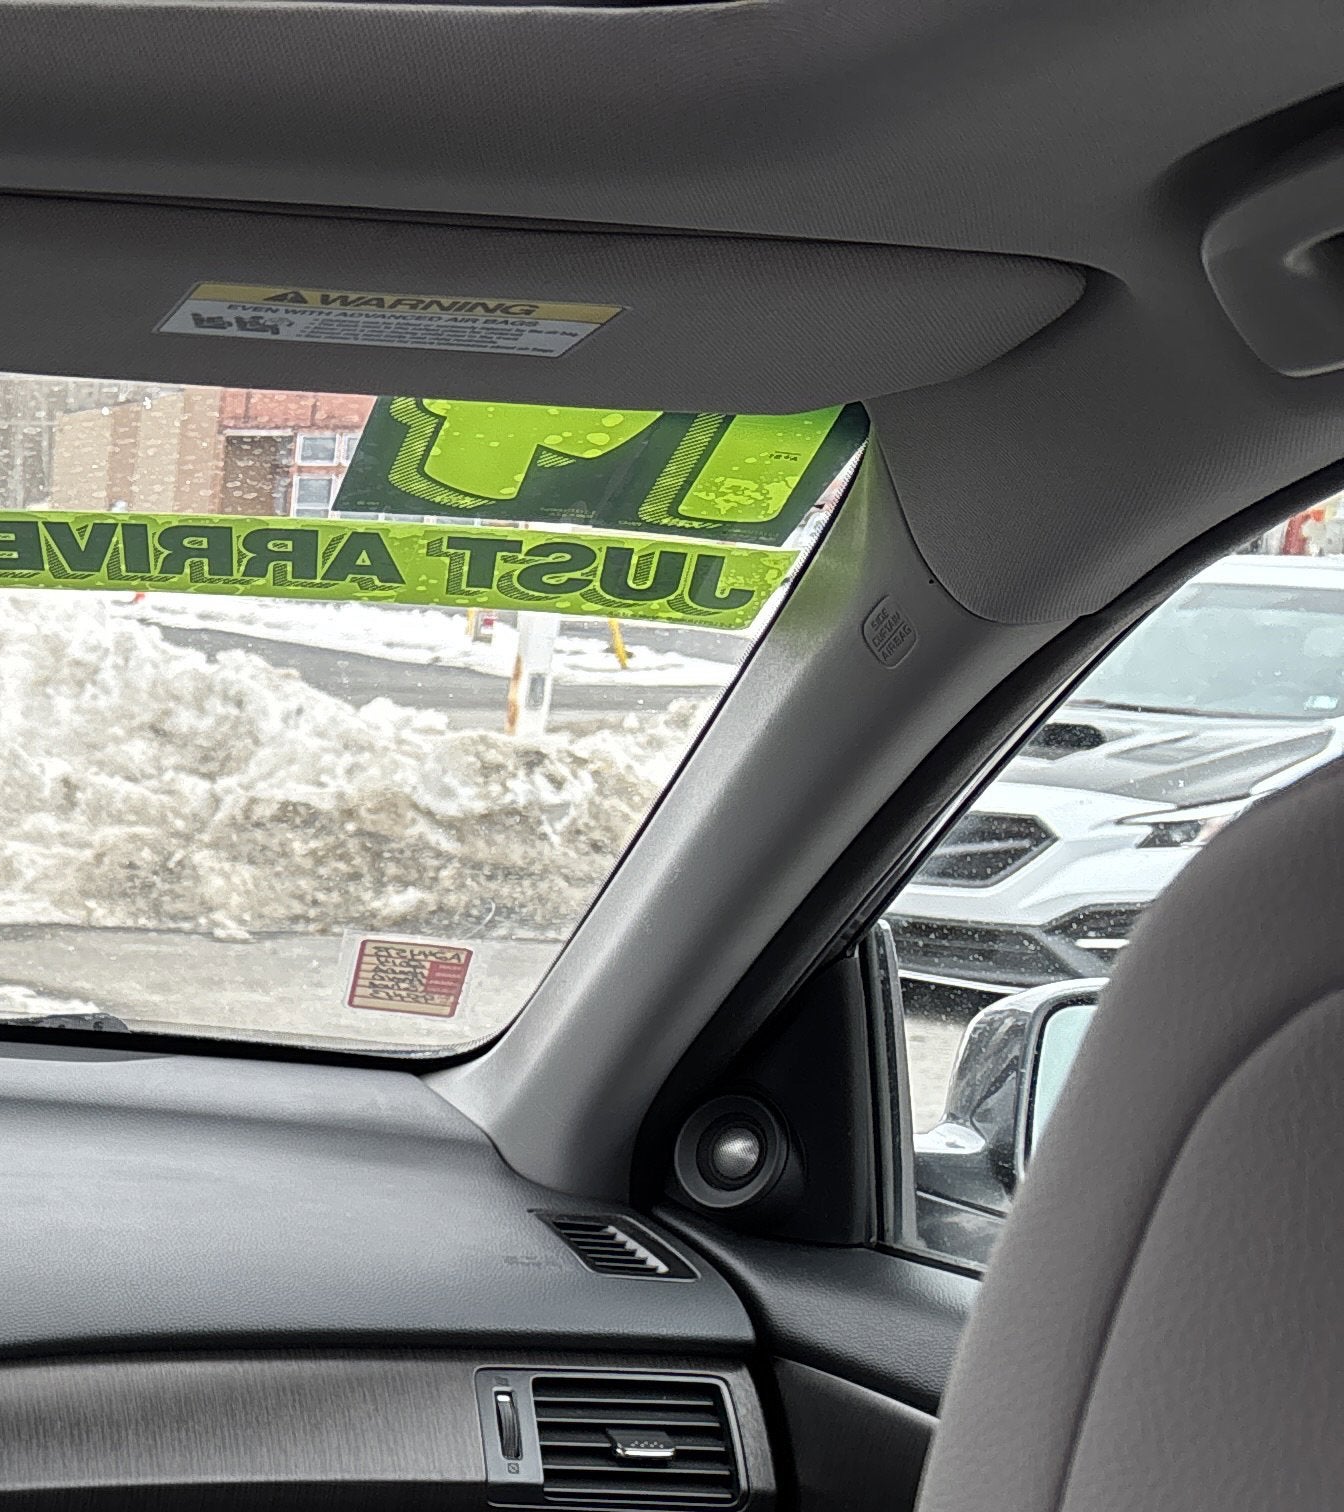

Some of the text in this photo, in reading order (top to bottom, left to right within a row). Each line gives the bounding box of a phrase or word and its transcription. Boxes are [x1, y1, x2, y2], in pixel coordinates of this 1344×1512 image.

[227, 304, 280, 314] EVEN
[284, 308, 333, 317] WITH
[335, 311, 442, 322] ADVANCED
[444, 316, 477, 324] AIR
[320, 293, 540, 316] WARNING
